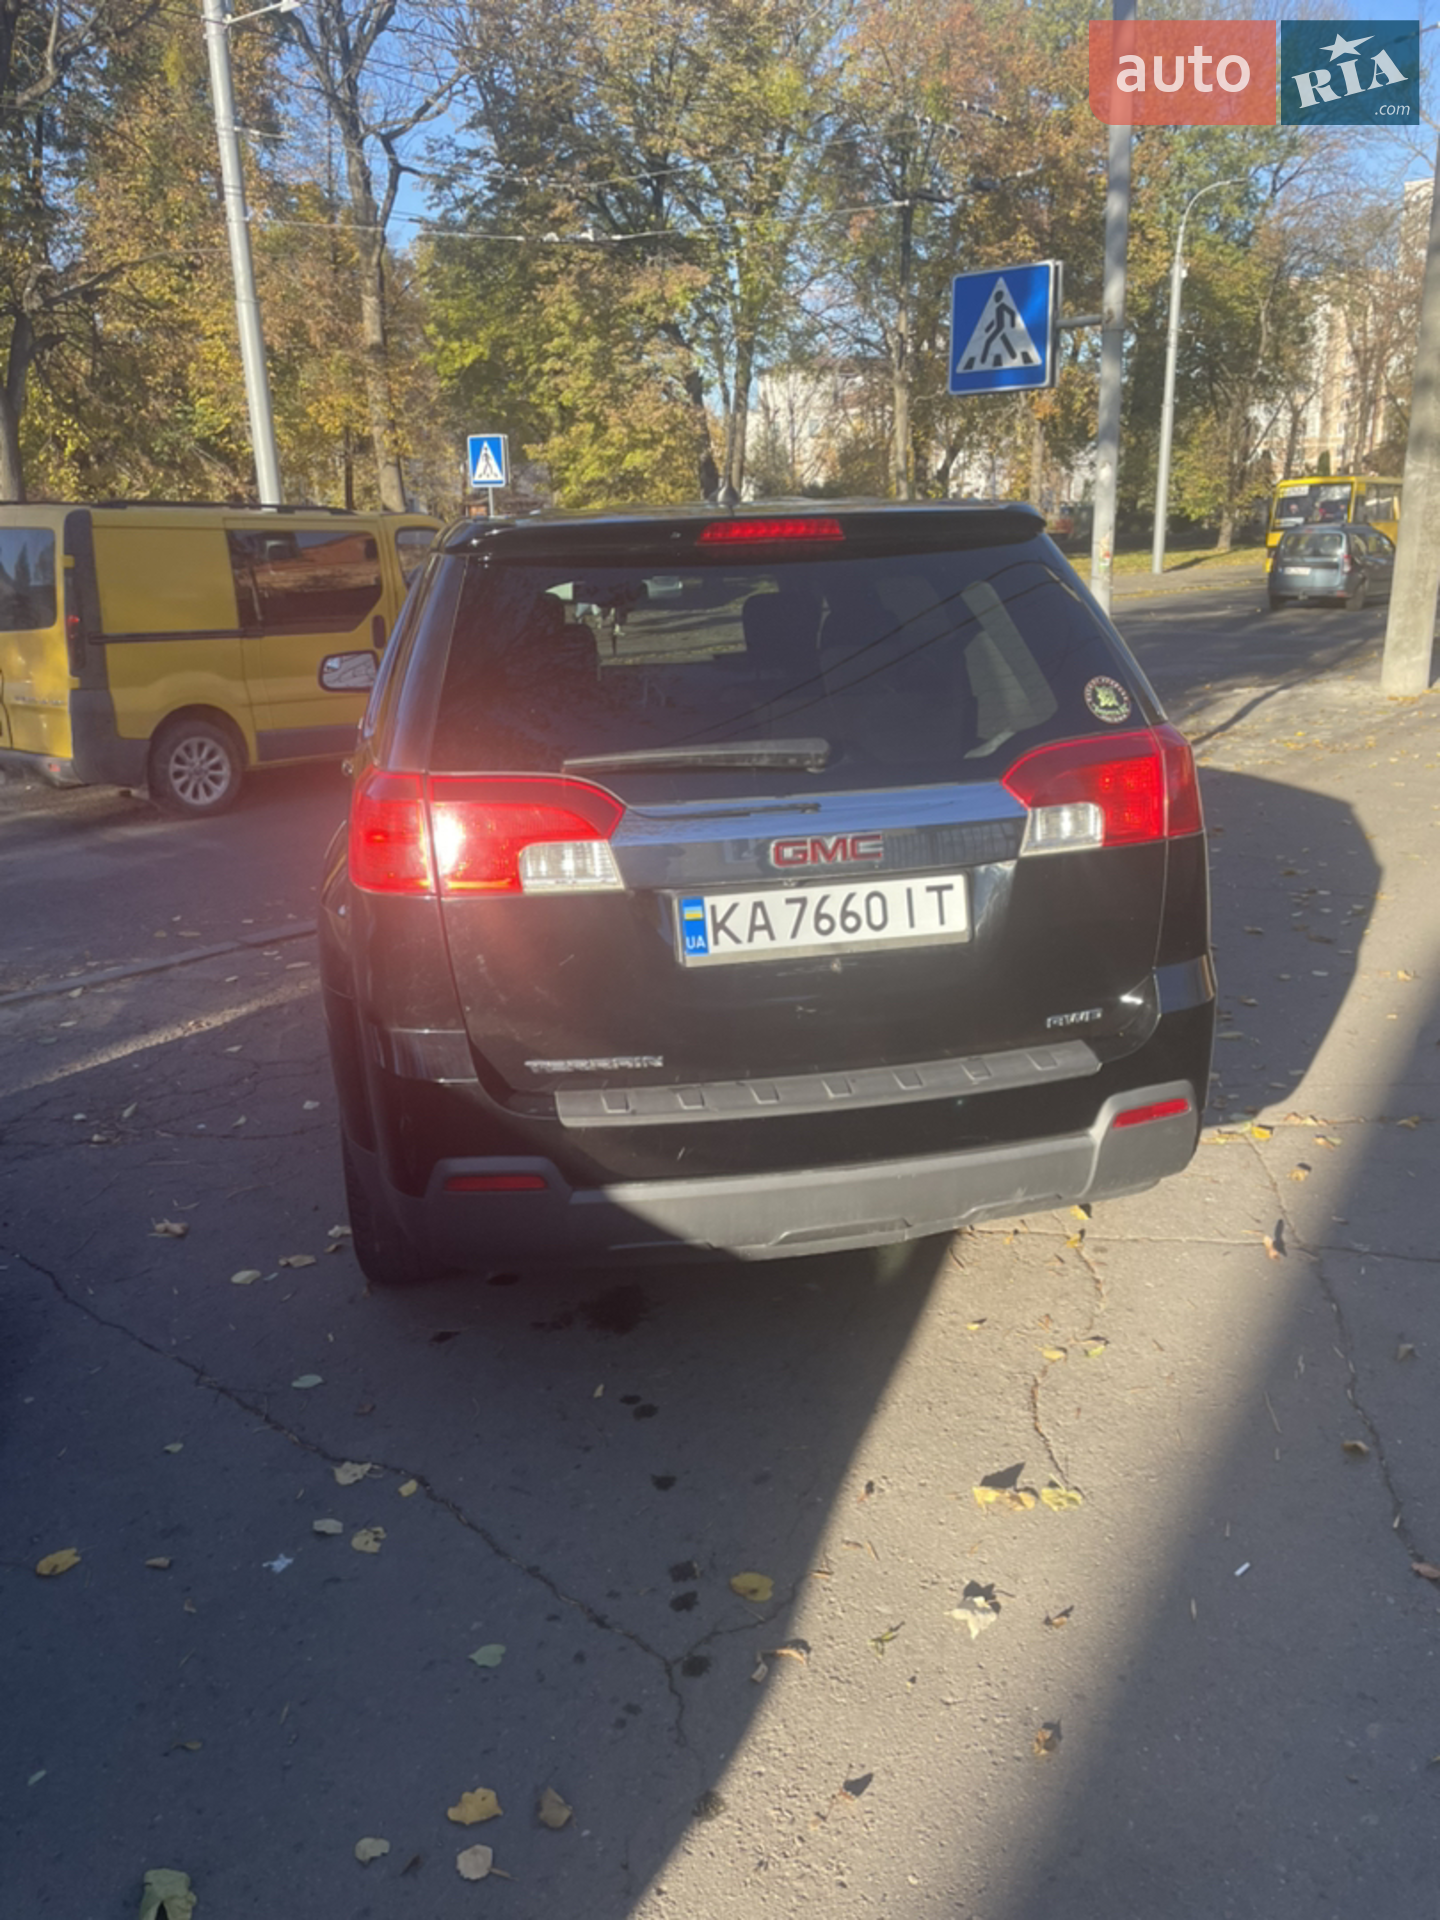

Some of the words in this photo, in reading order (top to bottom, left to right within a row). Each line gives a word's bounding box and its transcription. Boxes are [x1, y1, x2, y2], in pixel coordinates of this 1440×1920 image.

[770, 831, 884, 869] GMC
[710, 900, 776, 946] KA
[784, 890, 889, 939] 7660
[906, 883, 954, 929] IT
[686, 935, 706, 950] UA
